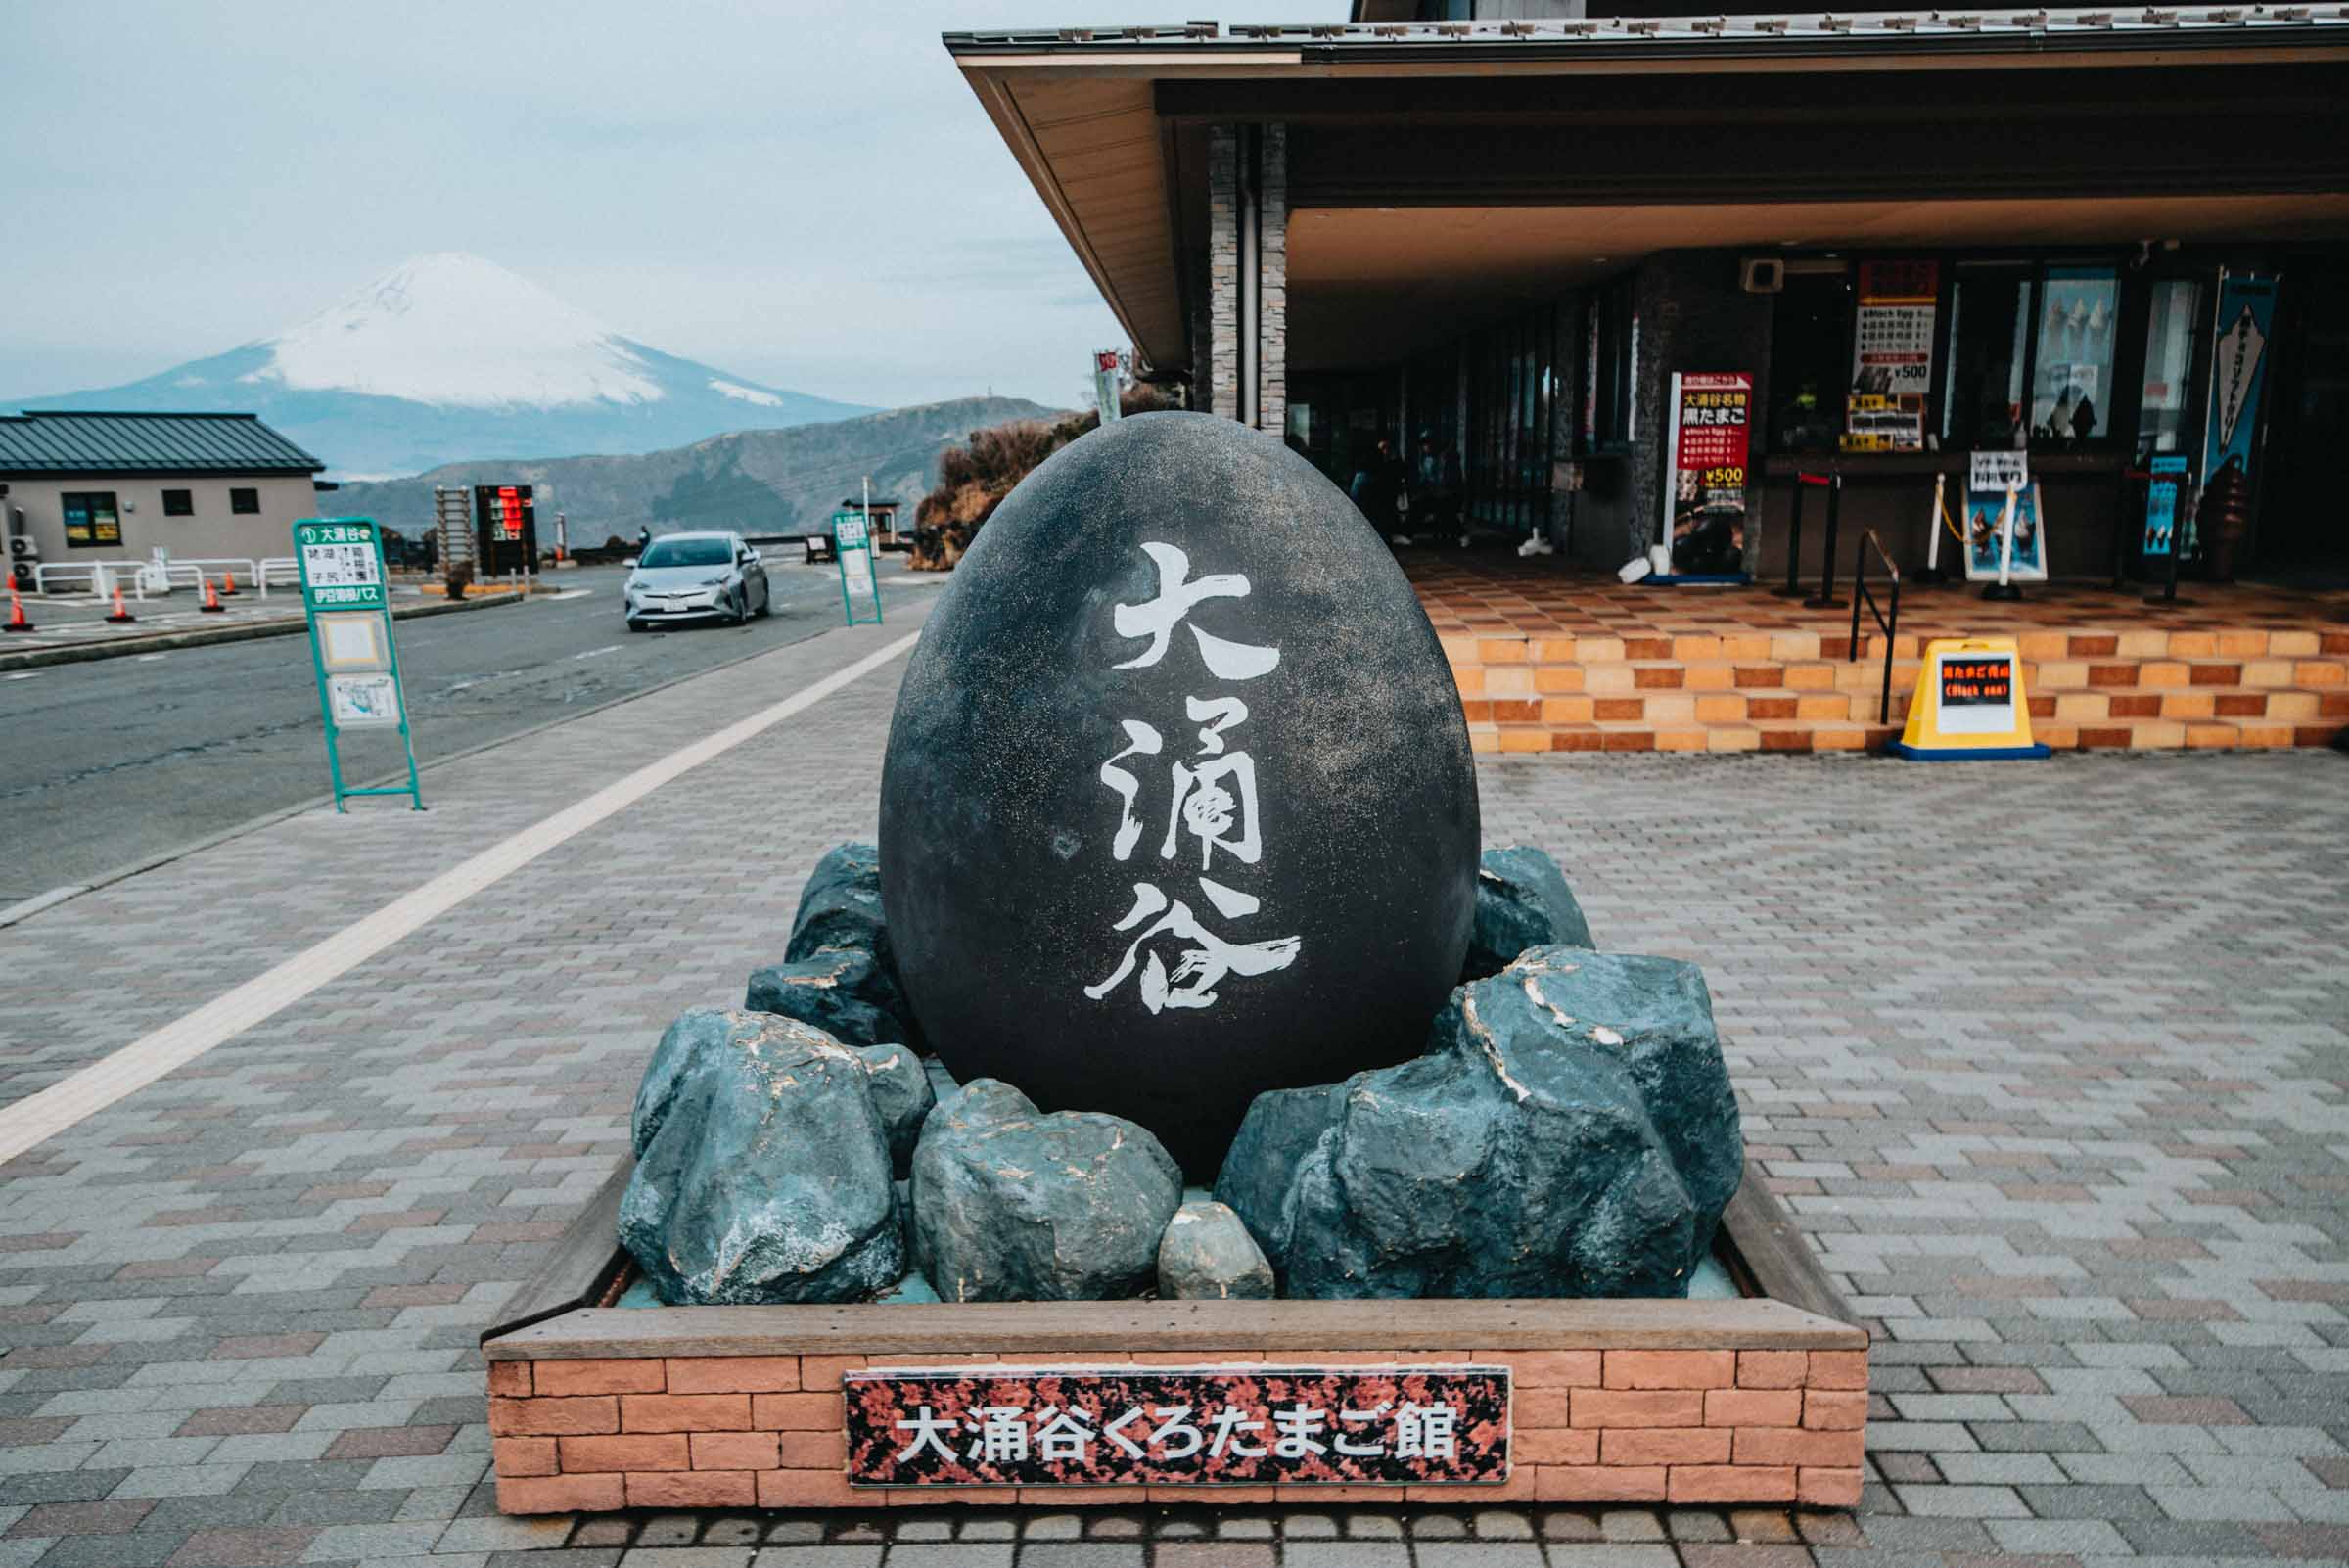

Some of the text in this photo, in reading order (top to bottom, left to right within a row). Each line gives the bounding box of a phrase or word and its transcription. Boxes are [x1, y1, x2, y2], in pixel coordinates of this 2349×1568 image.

[1895, 365, 1927, 379] ¥500
[1706, 467, 1743, 483] ¥500
[1083, 541, 1302, 1016] 大涌谷
[896, 1401, 1457, 1463] 大涌谷くろたまご館
